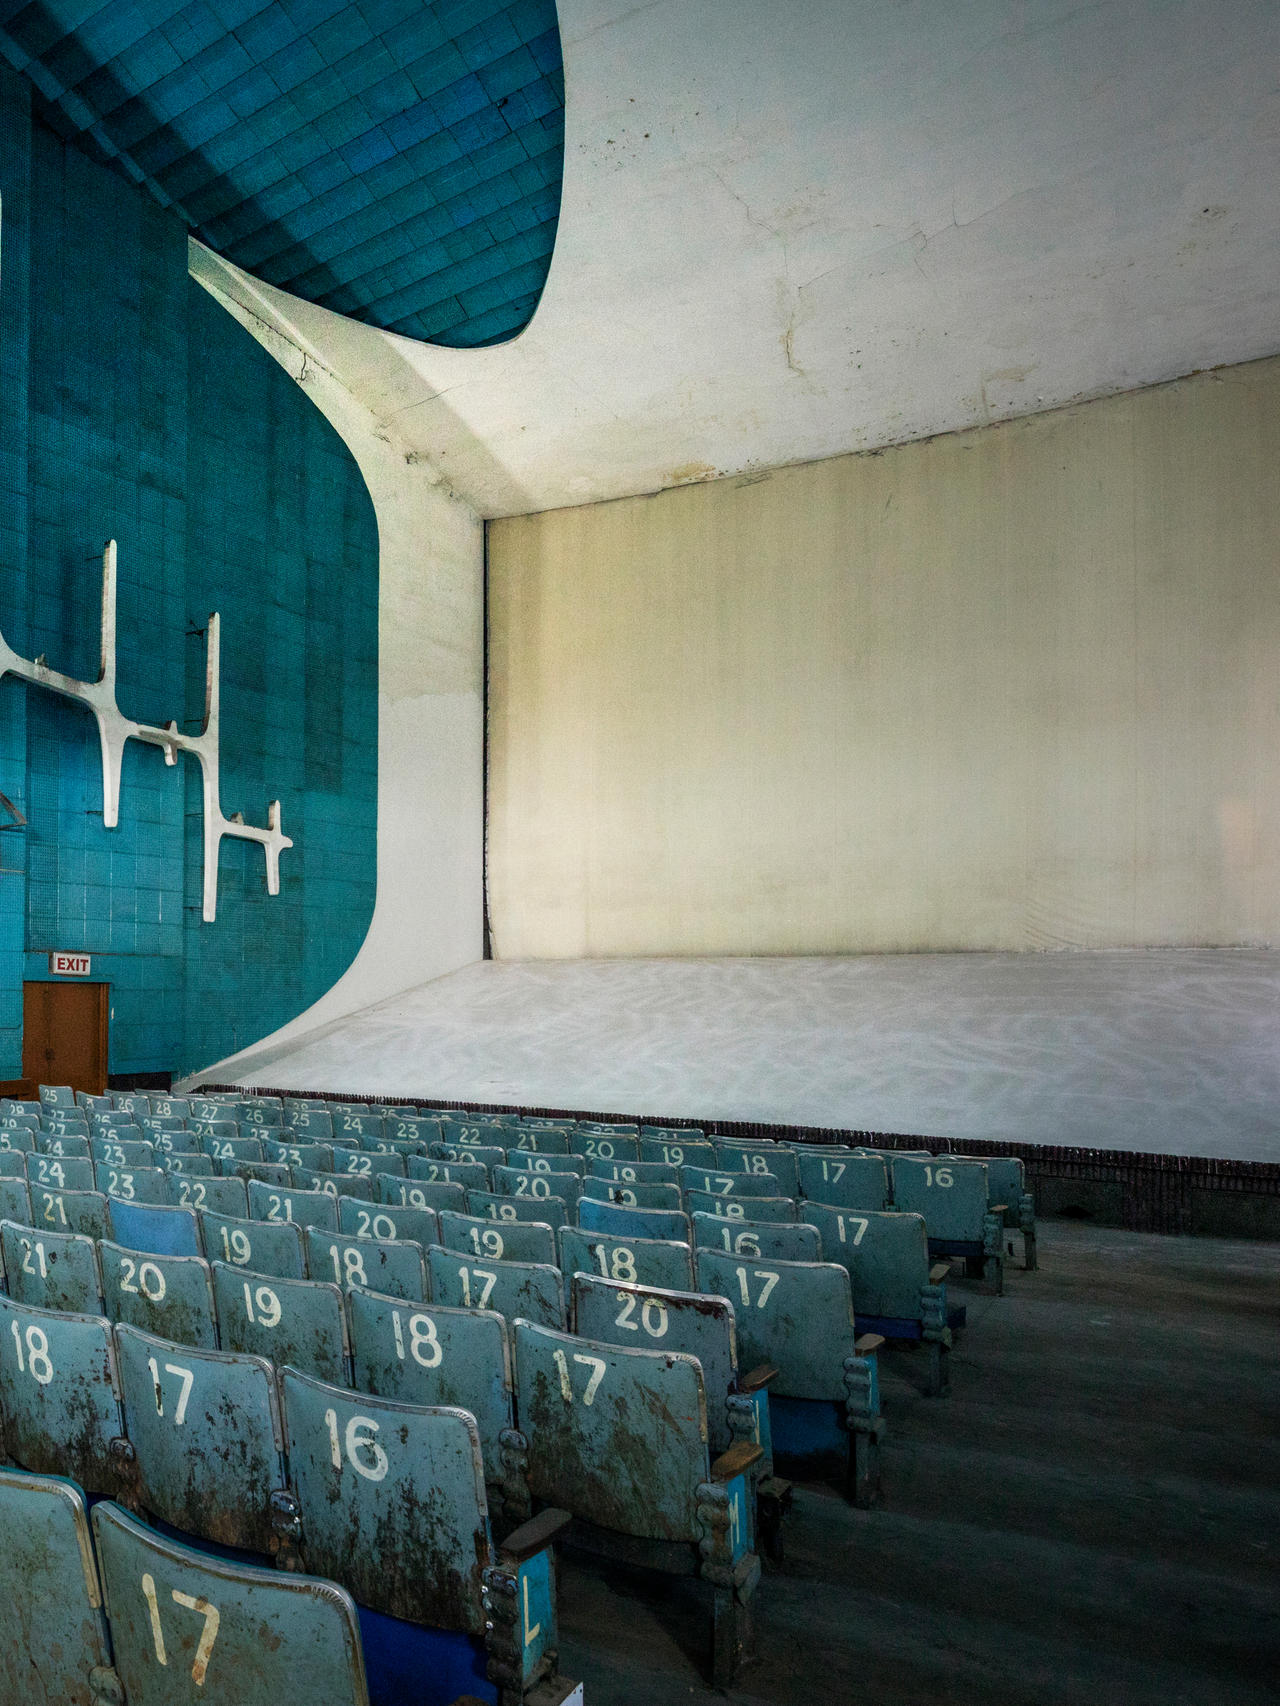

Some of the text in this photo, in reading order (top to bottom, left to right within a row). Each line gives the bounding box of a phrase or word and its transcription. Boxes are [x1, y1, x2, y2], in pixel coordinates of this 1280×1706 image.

[57, 958, 89, 972] EXIT
[44, 1089, 58, 1103] 25
[119, 1097, 134, 1112] 26
[156, 1102, 171, 1116] 28
[202, 1104, 218, 1119] 27
[246, 1109, 263, 1123] 26
[292, 1112, 310, 1126] 25
[344, 1116, 362, 1134] 24
[397, 1123, 419, 1138] 23
[460, 1127, 481, 1144] 22
[104, 1145, 126, 1165] 23
[154, 1134, 173, 1152] 25
[212, 1141, 235, 1158] 24
[518, 1134, 537, 1151] 21
[586, 1141, 614, 1159] 20
[278, 1148, 303, 1167] 23
[347, 1155, 372, 1175] 22
[663, 1147, 684, 1167] 19
[742, 1154, 769, 1174] 18
[39, 1160, 65, 1187] 24
[108, 1171, 135, 1199] 23
[428, 1165, 449, 1182] 21
[823, 1160, 846, 1184] 17
[924, 1167, 954, 1188] 16
[180, 1182, 207, 1210] 22
[515, 1176, 550, 1198] 20
[705, 1177, 734, 1195] 17
[43, 1193, 67, 1225] 21
[268, 1195, 292, 1221] 21
[357, 1211, 396, 1240] 20
[837, 1216, 869, 1246] 17
[220, 1226, 251, 1264] 19
[470, 1227, 504, 1259] 19
[721, 1228, 761, 1256] 16
[20, 1238, 48, 1279] 21
[330, 1245, 368, 1287] 18
[595, 1245, 637, 1283] 18
[120, 1259, 166, 1301] 20
[459, 1267, 497, 1310] 17
[736, 1268, 780, 1307] 17
[243, 1283, 282, 1327] 19
[616, 1292, 668, 1337] 20
[11, 1319, 53, 1384] 18
[392, 1310, 442, 1368] 18
[553, 1349, 606, 1405] 17
[148, 1357, 194, 1425] 17
[325, 1408, 388, 1481] 16
[523, 1576, 541, 1647] L
[142, 1573, 219, 1686] 17
